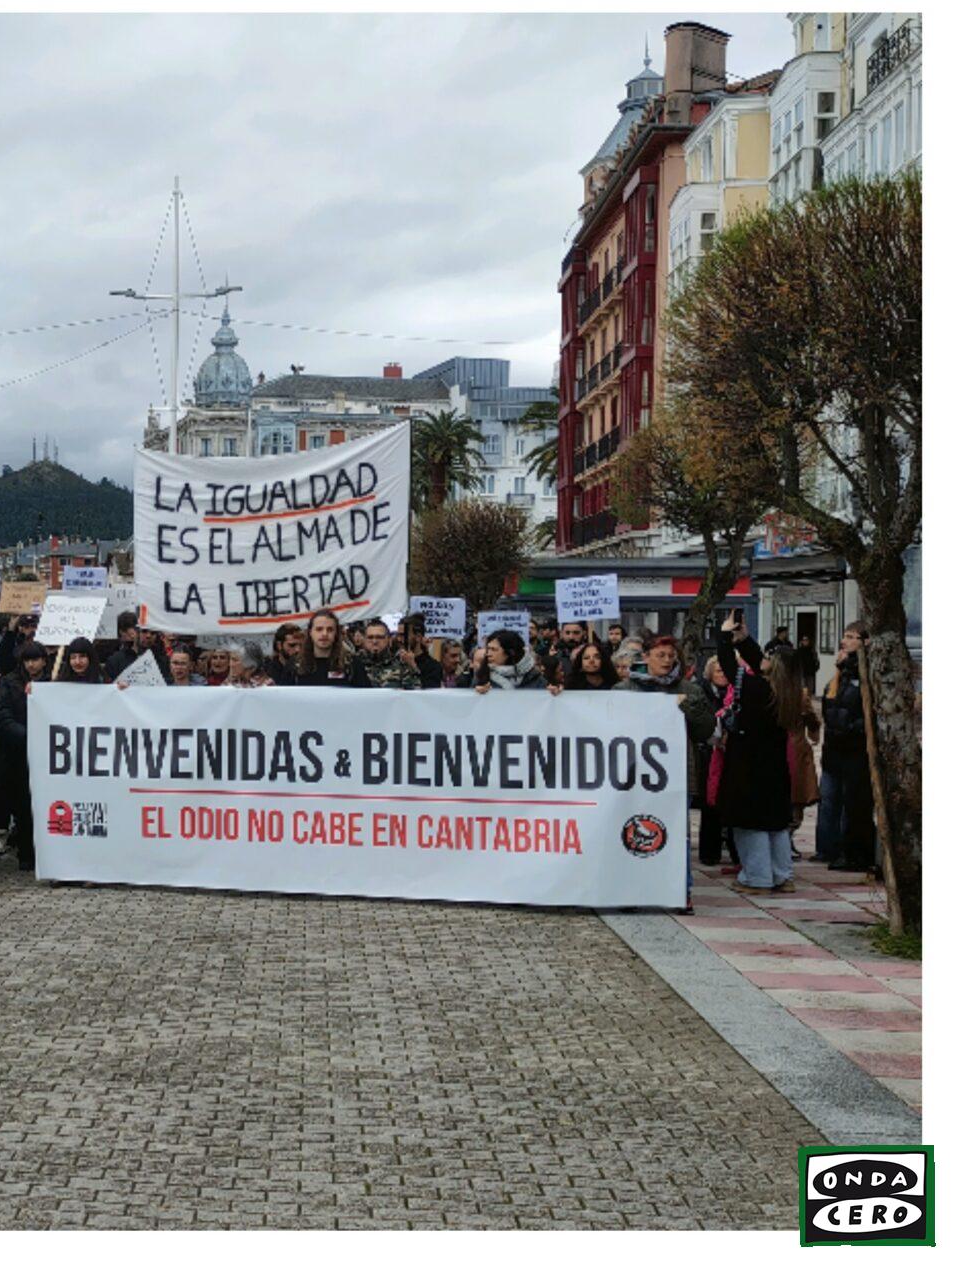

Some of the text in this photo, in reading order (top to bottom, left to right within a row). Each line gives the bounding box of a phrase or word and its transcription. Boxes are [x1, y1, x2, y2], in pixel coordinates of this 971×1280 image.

[153, 461, 378, 517] LA IGUALDAD
[157, 500, 391, 566] ES EL ALMA DE
[163, 580, 206, 615] LA
[218, 564, 371, 618] LIBERTAD
[49, 724, 669, 793] BIENVENIDAS & BIENVENIDOS
[141, 806, 172, 838] EL
[179, 806, 240, 841] ODIO
[247, 809, 284, 843] NO
[292, 810, 363, 847] CABE
[372, 812, 408, 848] EN
[417, 814, 583, 855] CANTABRIA
